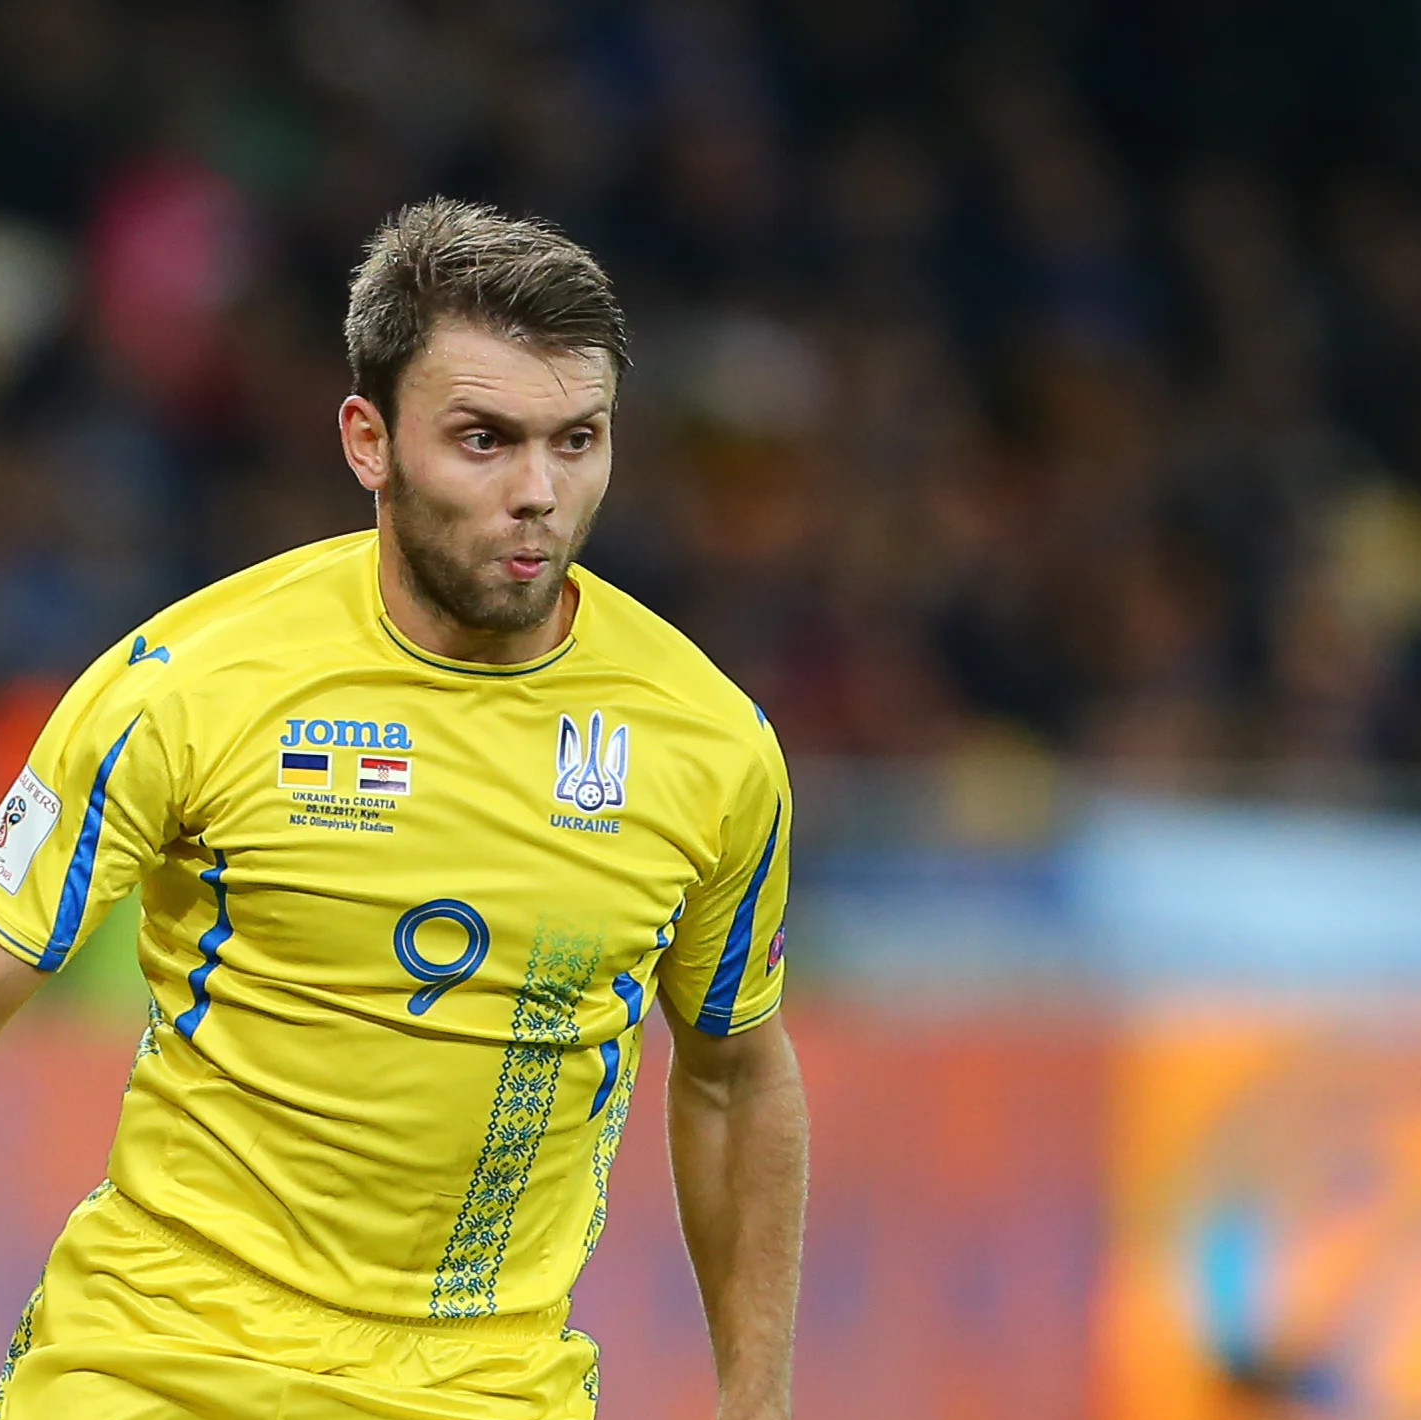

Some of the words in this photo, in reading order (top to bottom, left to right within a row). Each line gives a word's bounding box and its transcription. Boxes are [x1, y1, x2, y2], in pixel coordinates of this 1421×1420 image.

[292, 791, 337, 804] UKRAINE
[339, 797, 351, 805] vs
[353, 797, 396, 809] CROATIA
[289, 814, 308, 826] NSC
[360, 821, 394, 833] Stadium
[360, 809, 381, 820] Kyiv
[550, 813, 620, 834] UKRAINE
[393, 898, 491, 1016] 9
